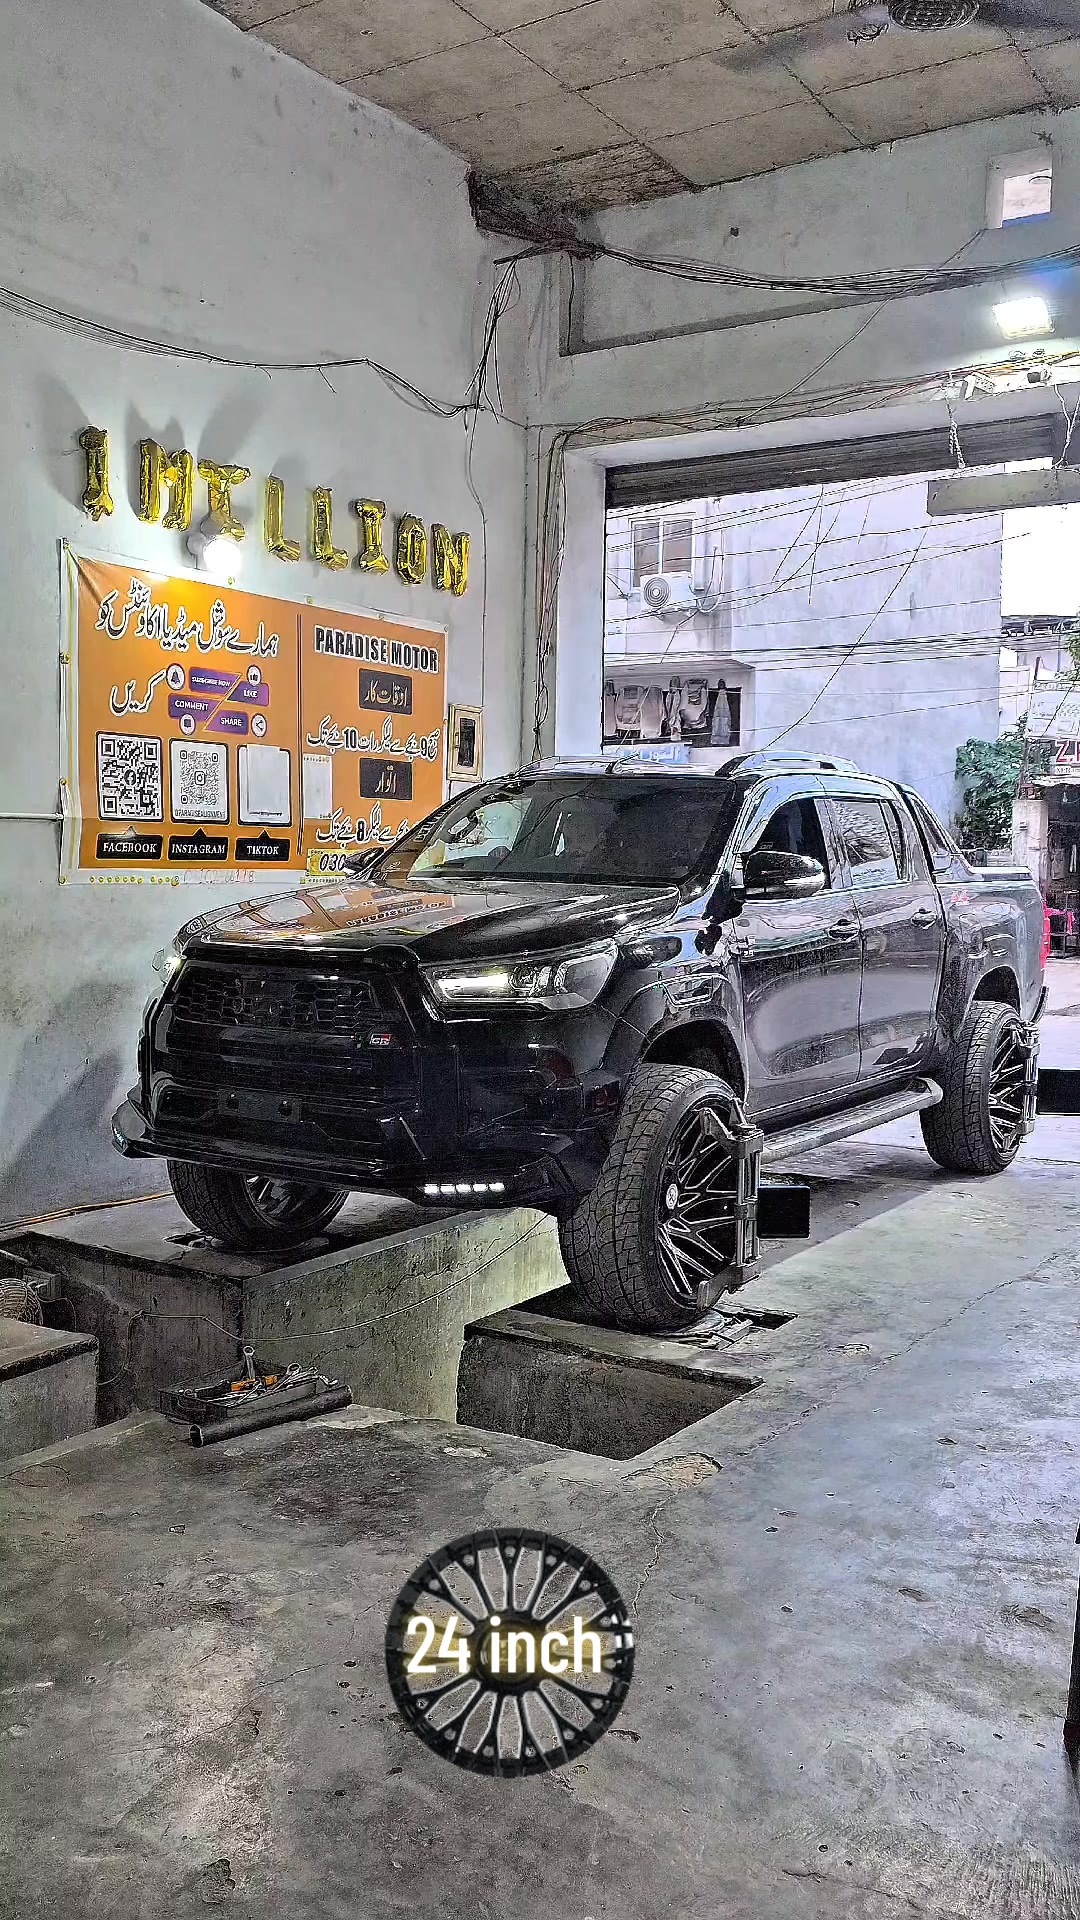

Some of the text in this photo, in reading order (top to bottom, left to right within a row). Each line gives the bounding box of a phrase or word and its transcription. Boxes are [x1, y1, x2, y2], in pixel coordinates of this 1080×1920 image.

[138, 437, 471, 597] MILLION
[95, 589, 119, 629] کو
[197, 598, 232, 653] سوشل
[226, 620, 279, 657] ہمارے
[315, 625, 439, 674] PARADISE MOTOR
[109, 669, 167, 716] کریں
[220, 717, 243, 727] SHARE
[326, 723, 344, 754] بجے
[342, 727, 358, 751] 10
[390, 739, 405, 756] سے
[404, 733, 421, 761] بجے
[420, 736, 429, 758] 9
[338, 816, 357, 850] بجے
[356, 818, 367, 843] 8
[102, 842, 158, 854] FACEBOOK
[171, 843, 226, 855] INSTAGRAM
[246, 845, 280, 856] TIKTOK
